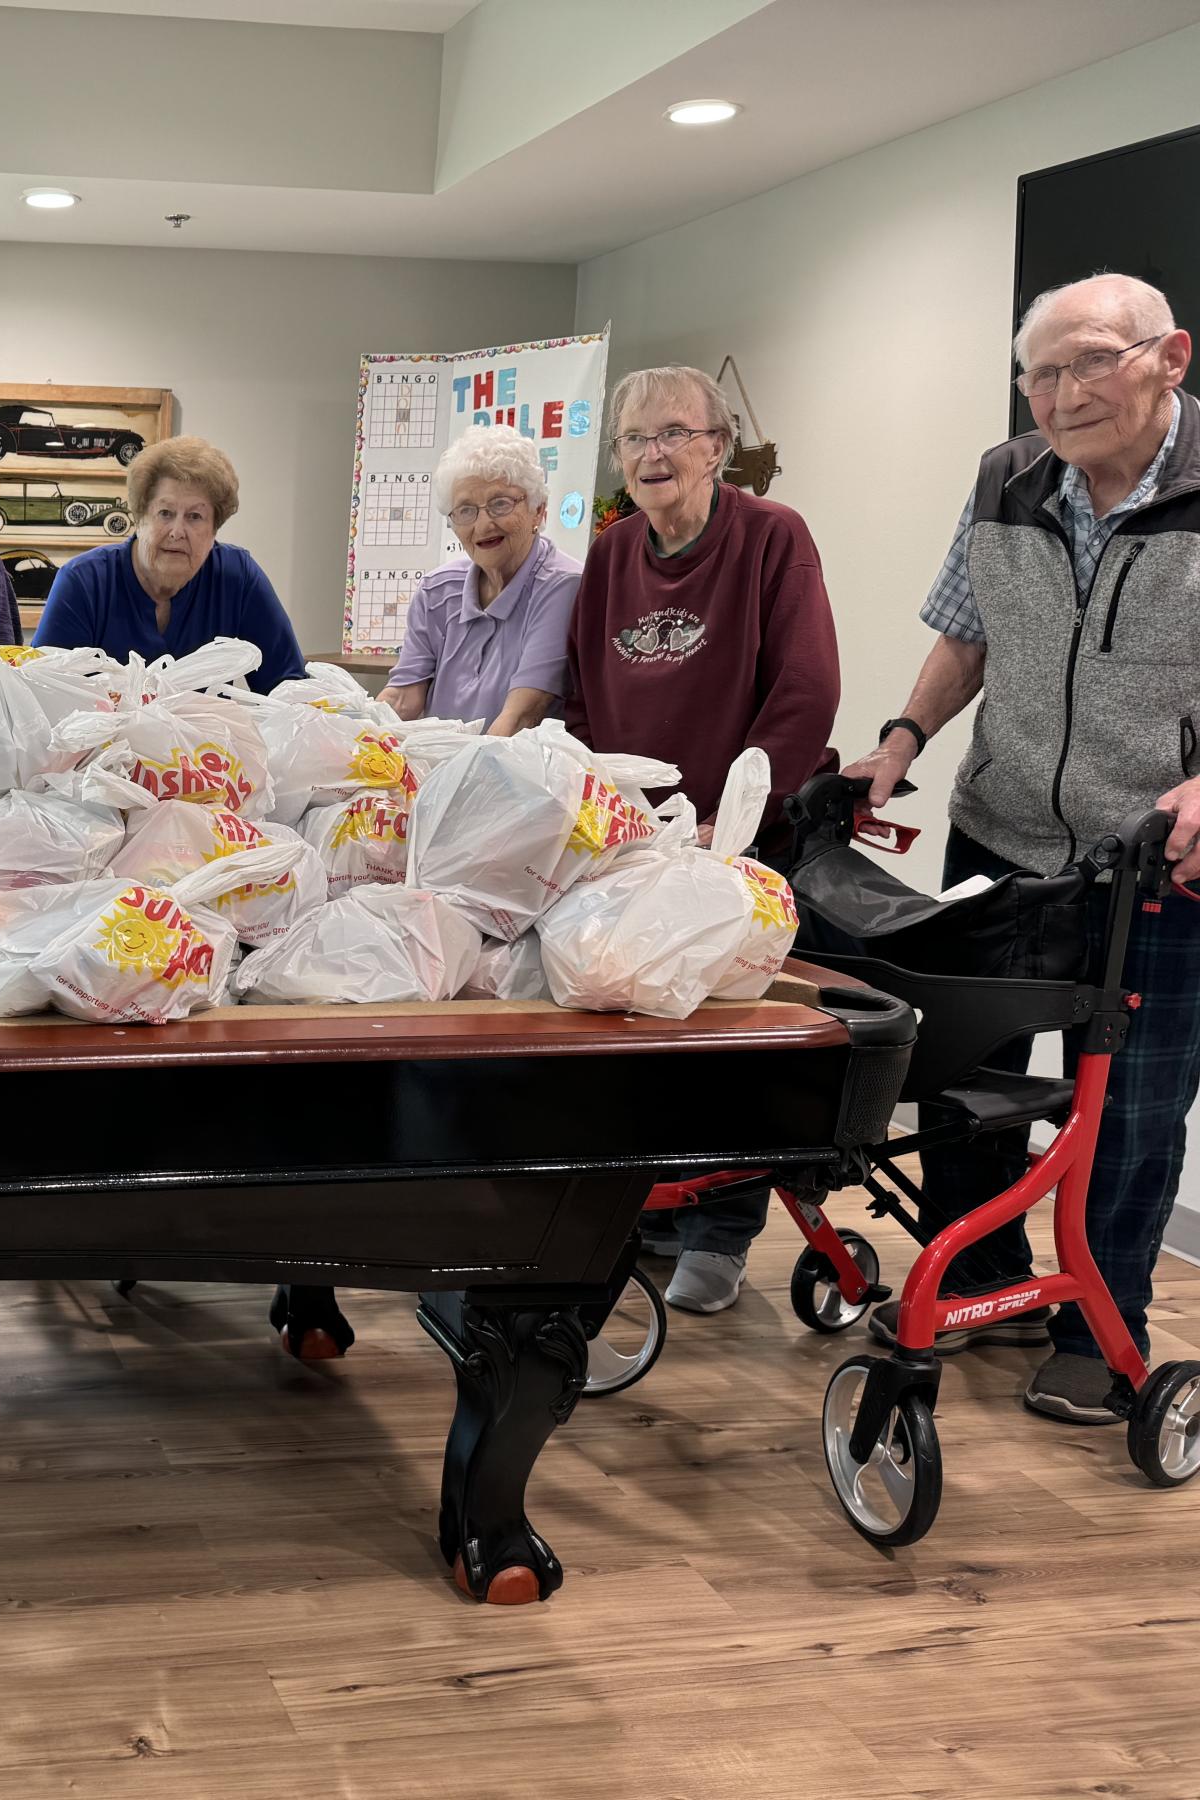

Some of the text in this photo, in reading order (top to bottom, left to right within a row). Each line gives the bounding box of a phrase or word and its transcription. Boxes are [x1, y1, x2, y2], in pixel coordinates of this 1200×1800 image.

[453, 367, 517, 412] THE
[366, 863, 394, 876] THANK
[524, 865, 537, 876] for
[56, 974, 69, 985] for
[68, 982, 109, 1012] supporting
[944, 1300, 994, 1327] NITRO
